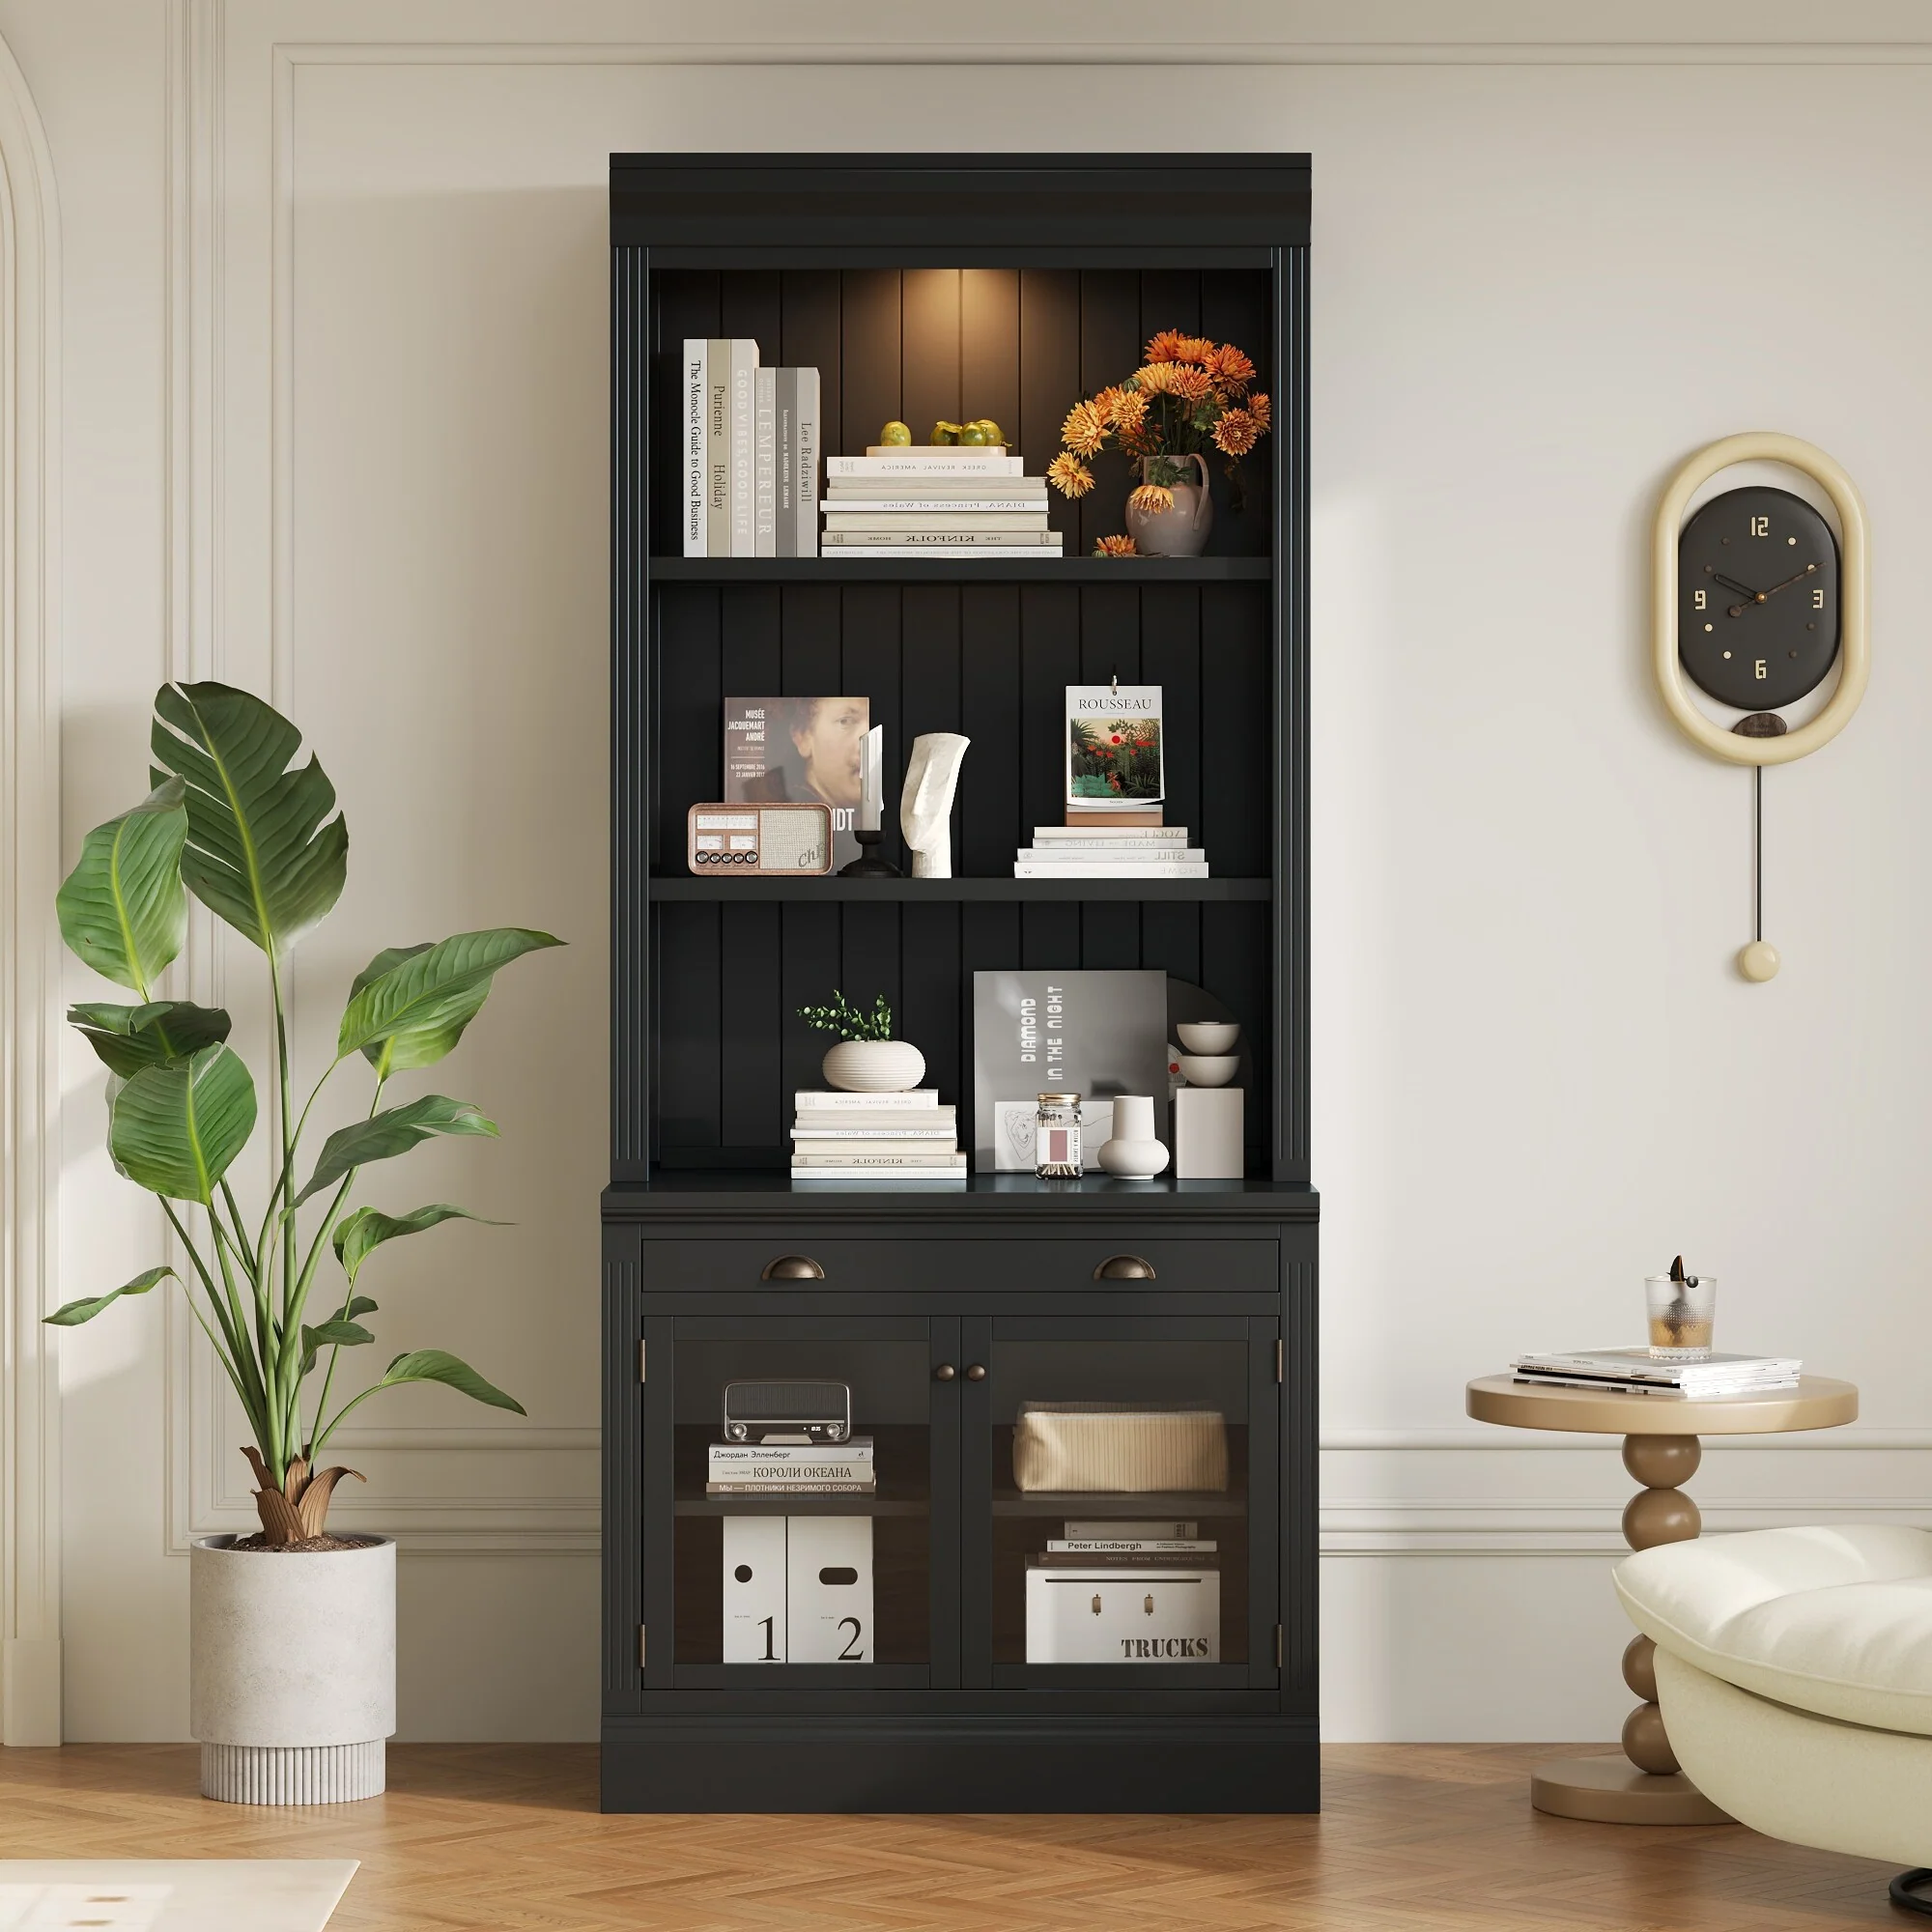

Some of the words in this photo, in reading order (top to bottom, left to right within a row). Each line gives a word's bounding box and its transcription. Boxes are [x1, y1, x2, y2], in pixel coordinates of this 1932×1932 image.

[691, 360, 701, 380] The
[737, 370, 748, 409] GOOD
[691, 383, 701, 424] Monocle
[714, 385, 724, 437] Purienne
[691, 425, 701, 455] Guide
[801, 422, 811, 442] Lee
[691, 458, 701, 468] to
[758, 410, 772, 534] LEMPEREUR
[801, 447, 811, 501] Radziwill
[691, 469, 701, 497] Good
[711, 465, 725, 510] Holiday
[737, 460, 748, 499] GOOD
[691, 499, 701, 540] Business
[737, 505, 747, 534] LIFE
[1750, 517, 1769, 537] 12
[1694, 589, 1706, 610] 9
[1812, 589, 1824, 610] 3
[1754, 659, 1767, 679] 6
[745, 708, 765, 720] MUSÉE
[1079, 698, 1151, 710] ROUSSEAU
[727, 721, 765, 730] JACQUEMART
[746, 731, 765, 742] ANDRÉ
[1047, 985, 1063, 1029] NIGHT
[1020, 998, 1037, 1063] DIAMOND
[1047, 1037, 1063, 1062] THE
[1047, 1067, 1063, 1080] IN
[753, 1467, 801, 1478] КОРОЛИ
[804, 1467, 852, 1478] ОКЕАНА
[1094, 1542, 1142, 1550] Lindbergh
[757, 1616, 781, 1661] 1
[837, 1616, 864, 1661] 2
[1121, 1638, 1208, 1658] TRUCKS
